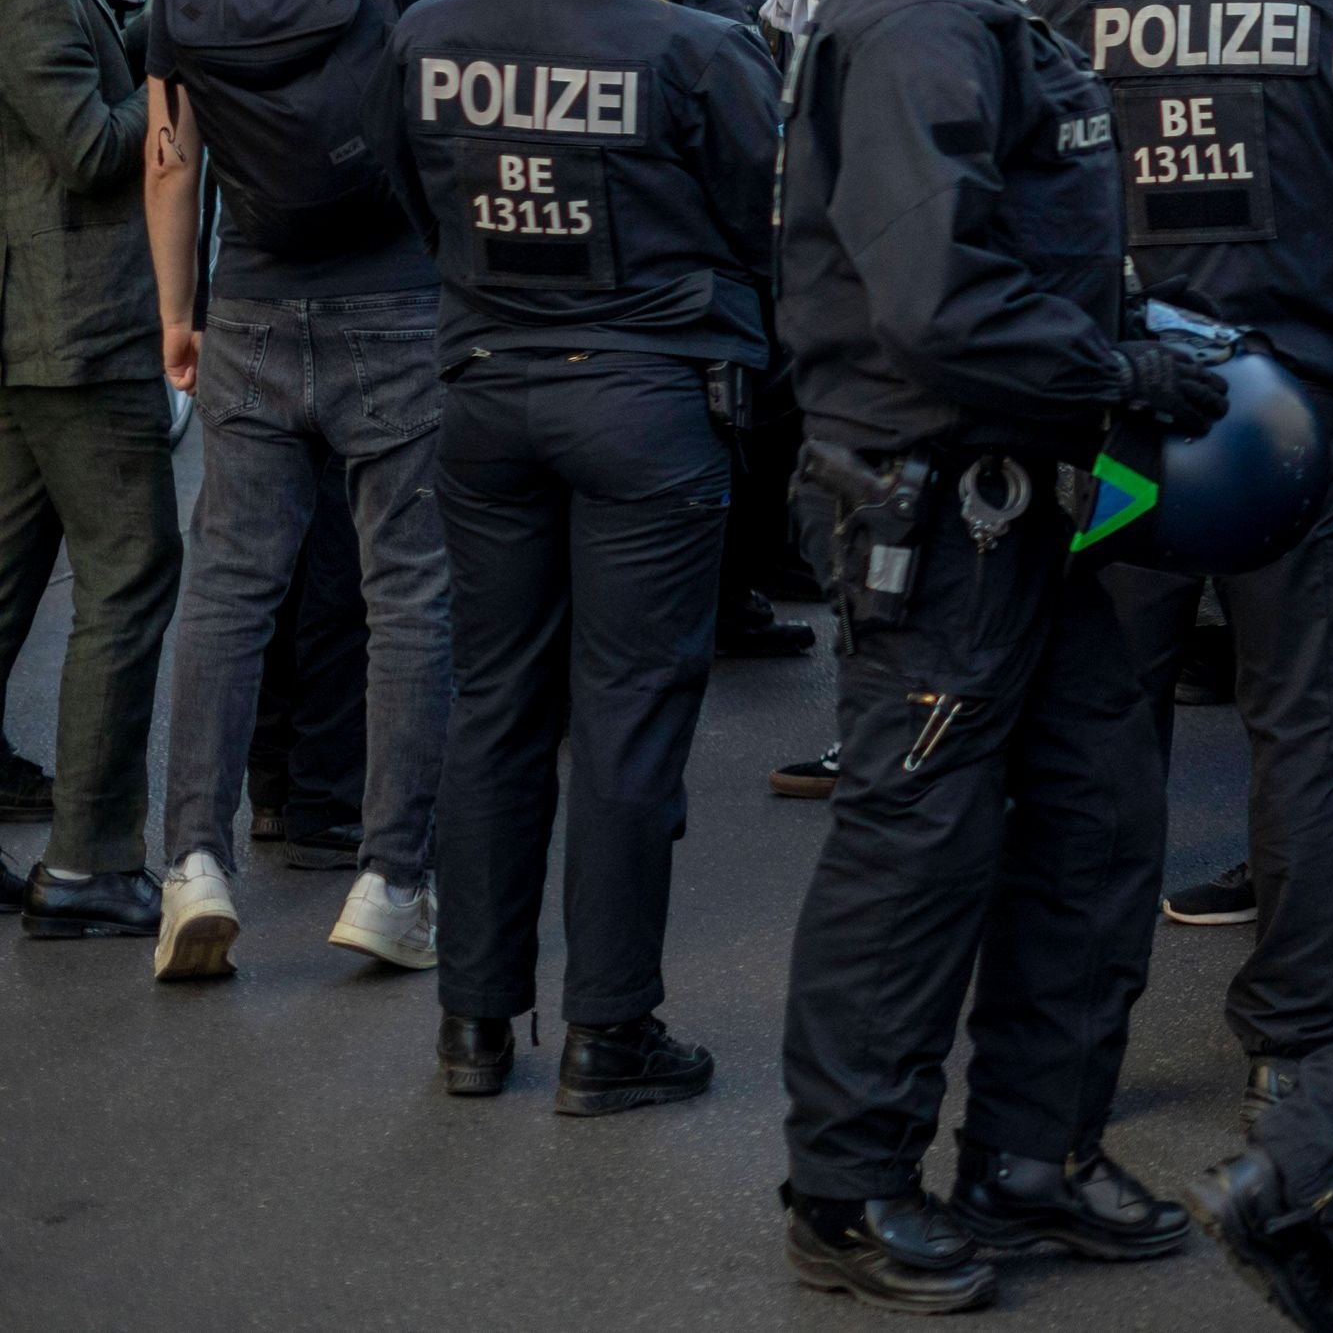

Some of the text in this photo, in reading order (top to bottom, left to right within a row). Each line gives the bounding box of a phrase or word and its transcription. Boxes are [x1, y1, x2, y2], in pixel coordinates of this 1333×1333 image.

[1093, 2, 1311, 70] POLIZEI
[420, 58, 638, 136] POLIZEI
[1160, 97, 1216, 138] BE
[499, 155, 555, 195] BE
[1134, 143, 1254, 184] 13111
[473, 196, 592, 235] 13115
